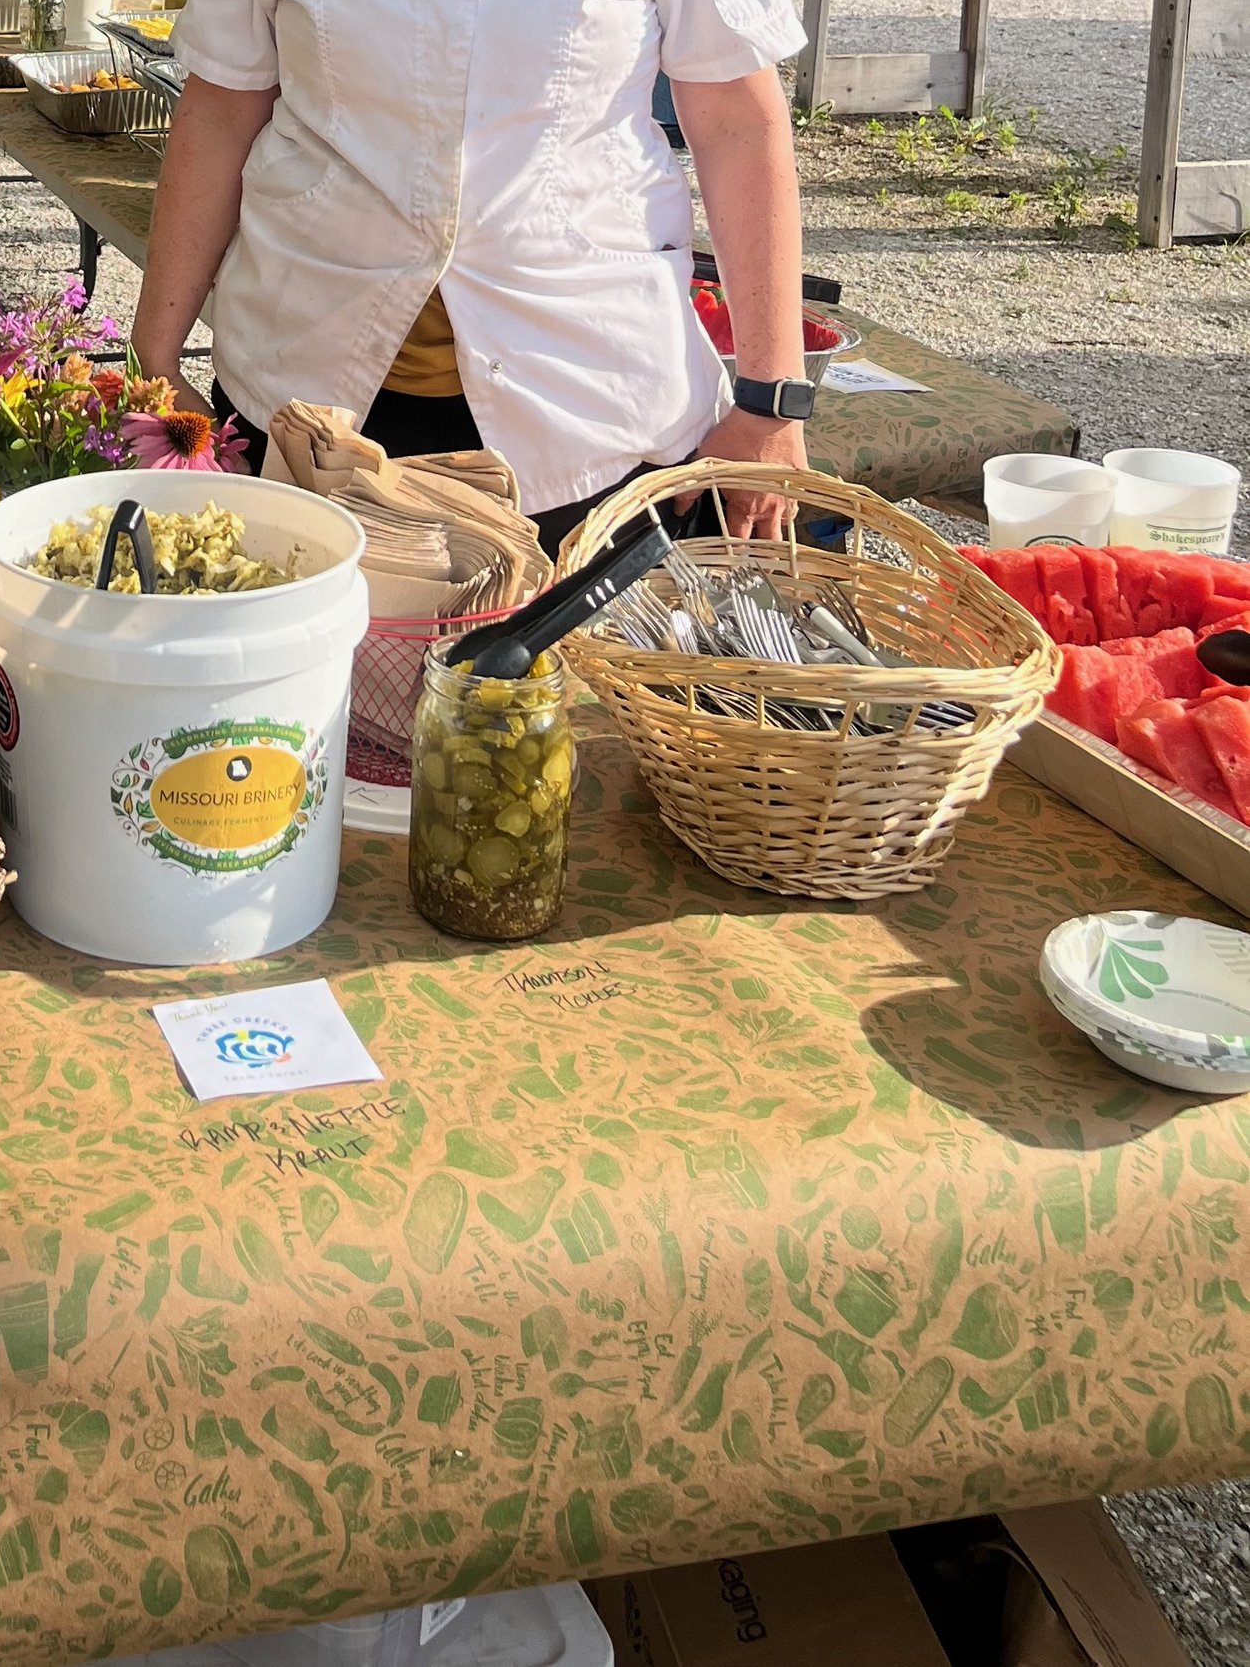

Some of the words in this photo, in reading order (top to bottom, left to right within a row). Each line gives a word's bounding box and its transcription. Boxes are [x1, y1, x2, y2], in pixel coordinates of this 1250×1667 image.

[159, 789, 239, 807] MISSOURI
[243, 782, 301, 804] BRINERY
[174, 816, 220, 826] CULINARY
[495, 961, 610, 994] THOMPSON
[550, 982, 635, 1011] PICKLES
[179, 1119, 262, 1154] RAMP
[288, 1099, 406, 1138] NETTLE
[266, 1134, 370, 1177] KRAUT
[965, 1228, 1019, 1269] Gather
[24, 1424, 50, 1460] Food
[183, 1465, 242, 1508] Gather
